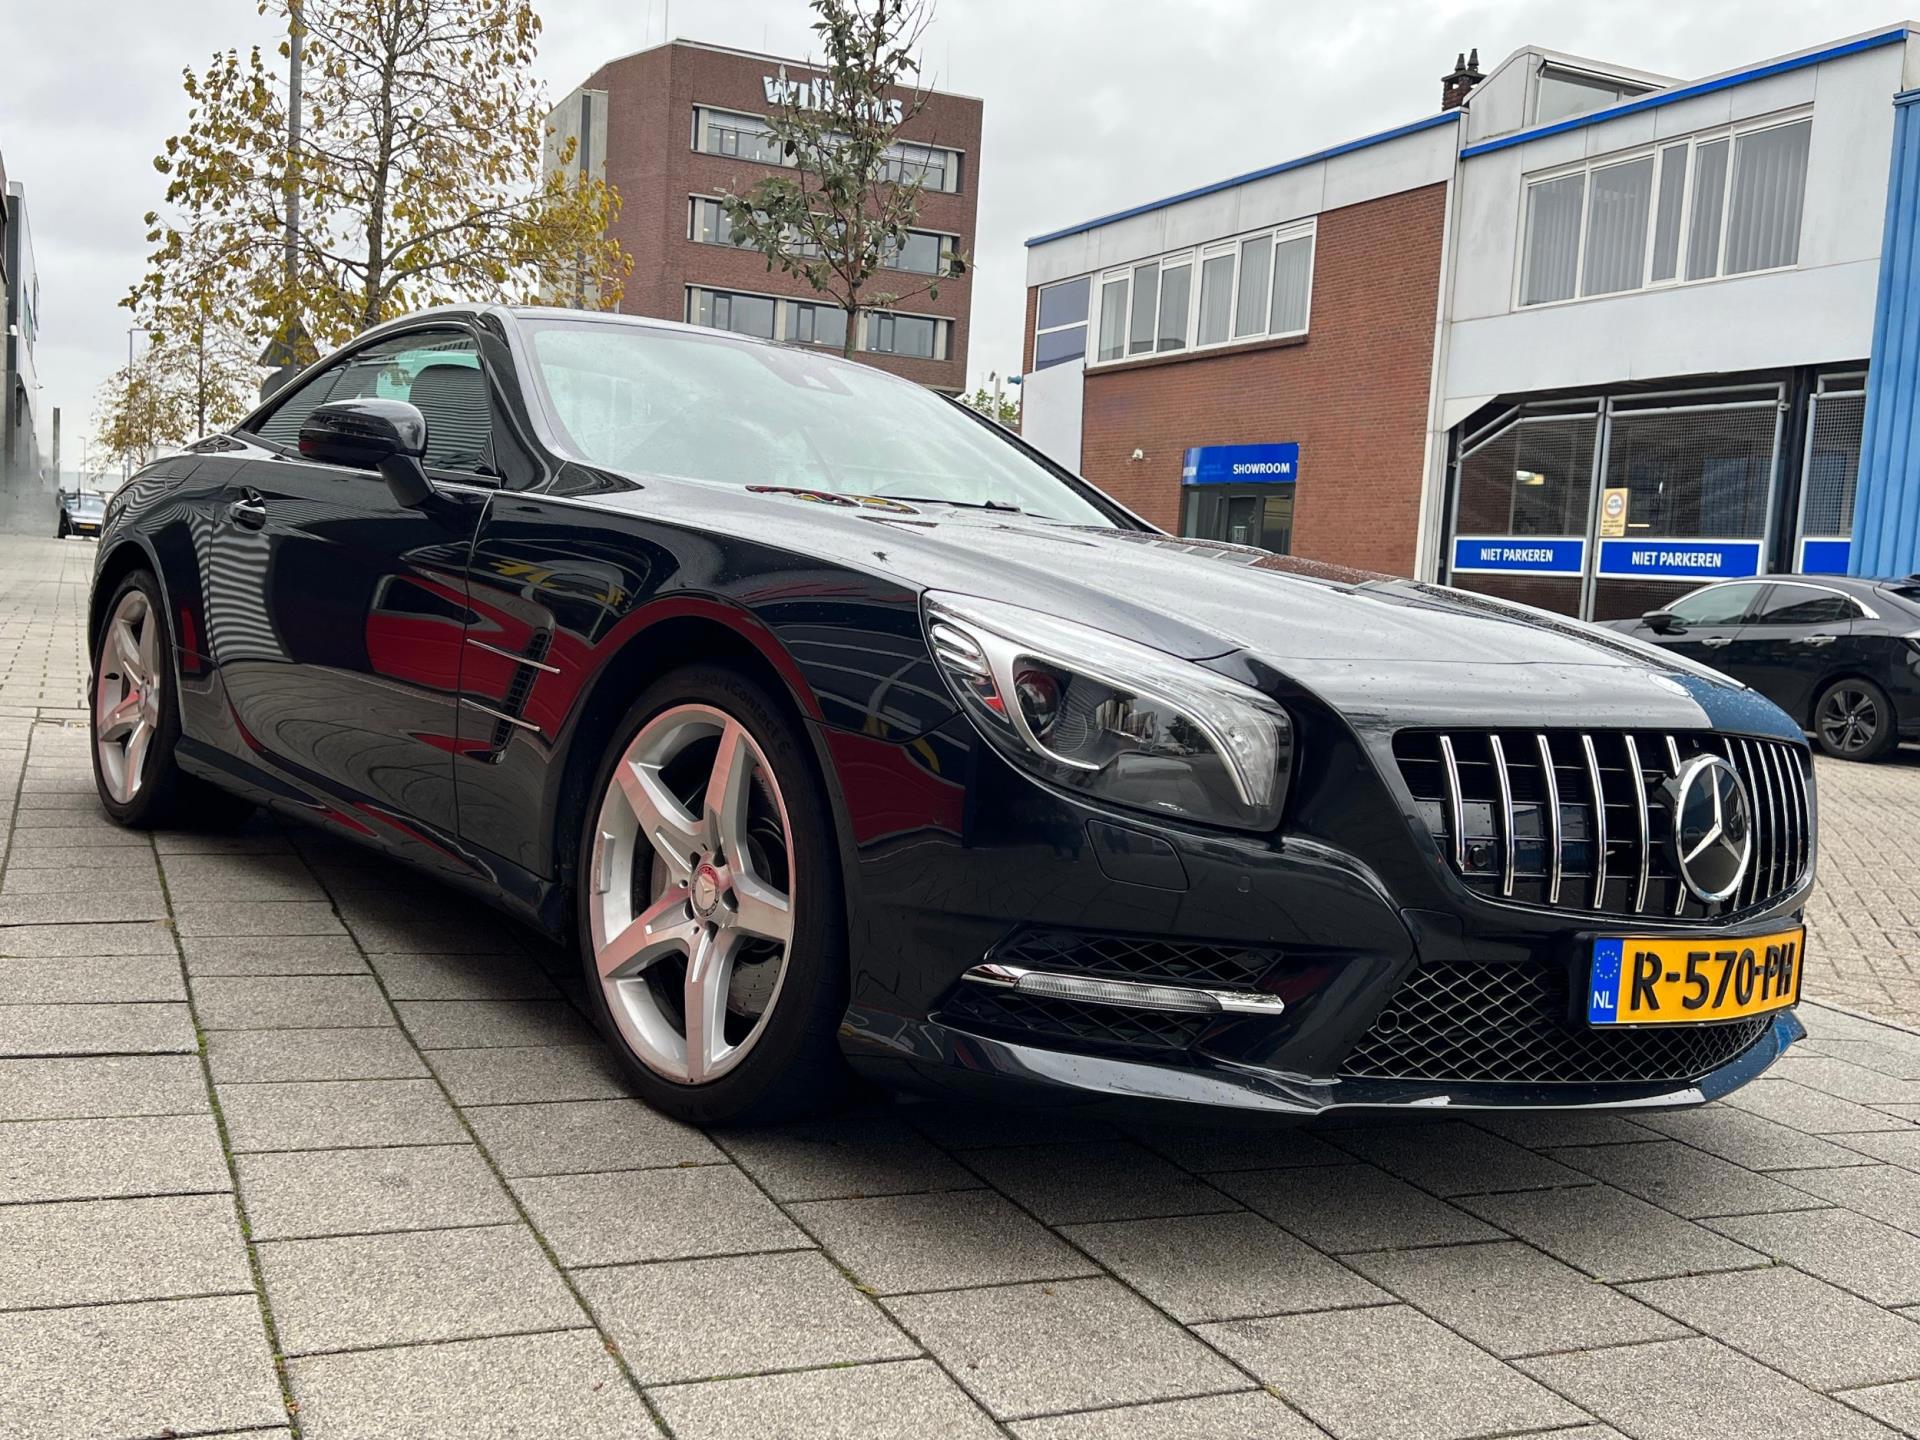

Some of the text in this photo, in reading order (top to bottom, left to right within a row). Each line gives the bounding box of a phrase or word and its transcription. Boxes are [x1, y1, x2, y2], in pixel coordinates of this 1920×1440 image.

[1232, 462, 1290, 475] SHOWROOM
[1480, 547, 1553, 562] NIET PARKEREN
[1631, 551, 1722, 568] NIET PARKEREN
[1630, 942, 1796, 1011] R-570-PH
[1592, 991, 1614, 1009] NL
